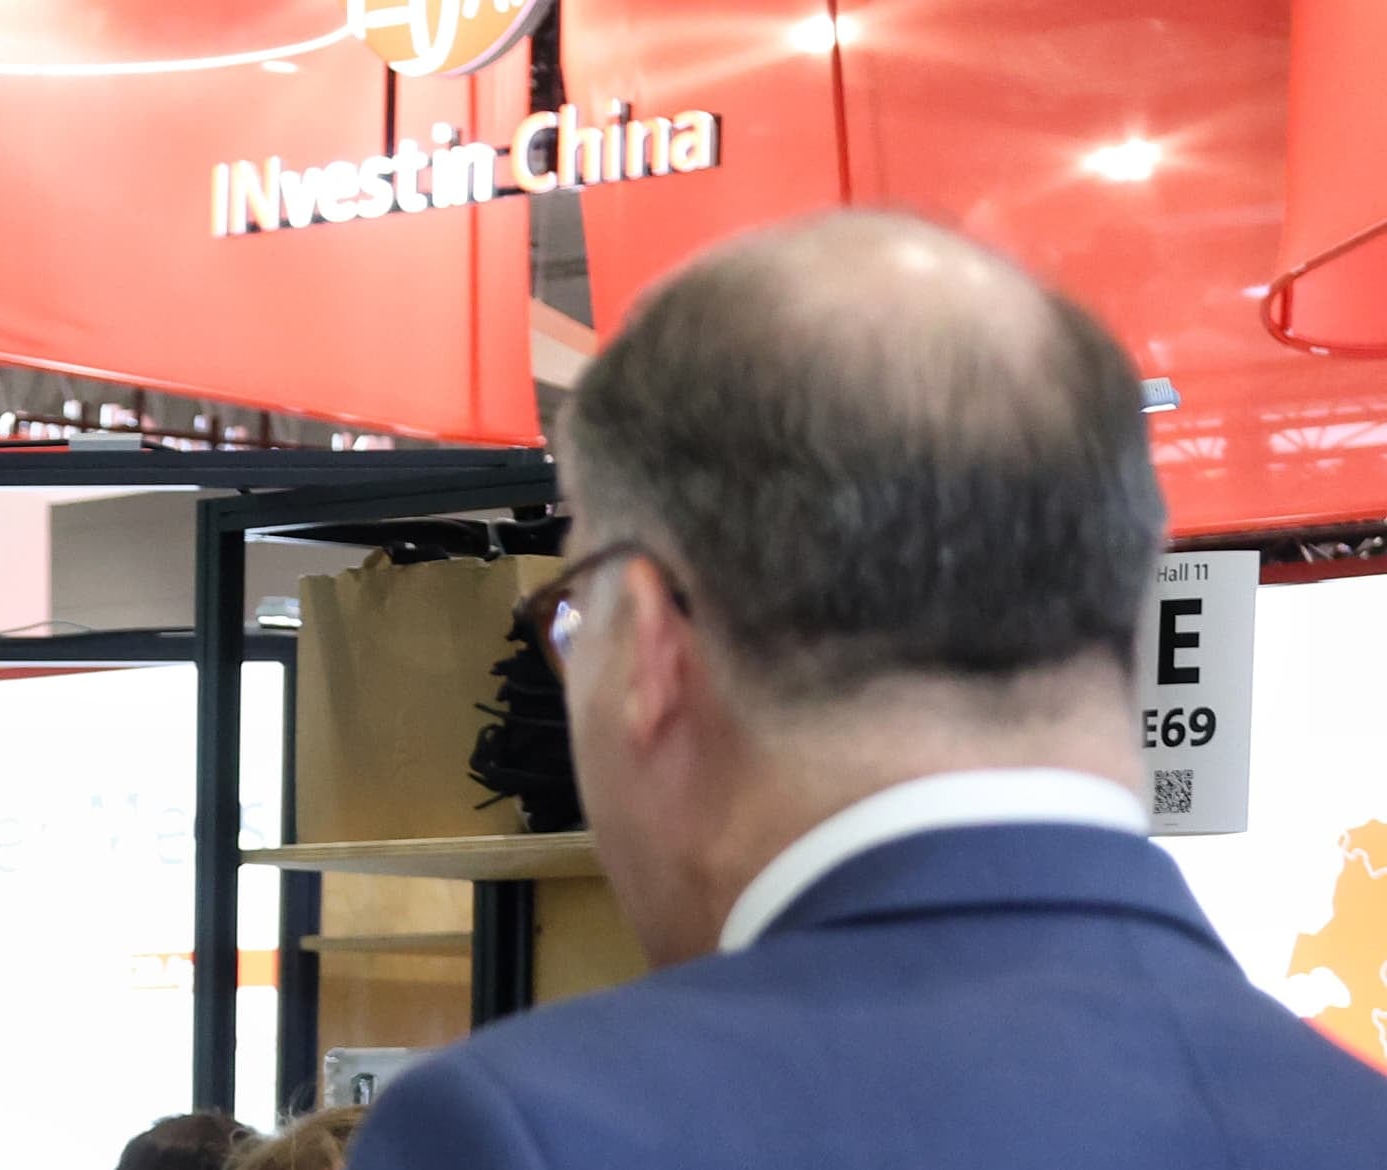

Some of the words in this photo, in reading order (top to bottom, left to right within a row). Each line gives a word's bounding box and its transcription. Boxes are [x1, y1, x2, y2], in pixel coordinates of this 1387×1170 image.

[430, 121, 496, 208] in
[511, 98, 721, 192] China
[1156, 563, 1189, 582] Hall
[1194, 563, 1209, 580] 11
[1157, 598, 1202, 685] E
